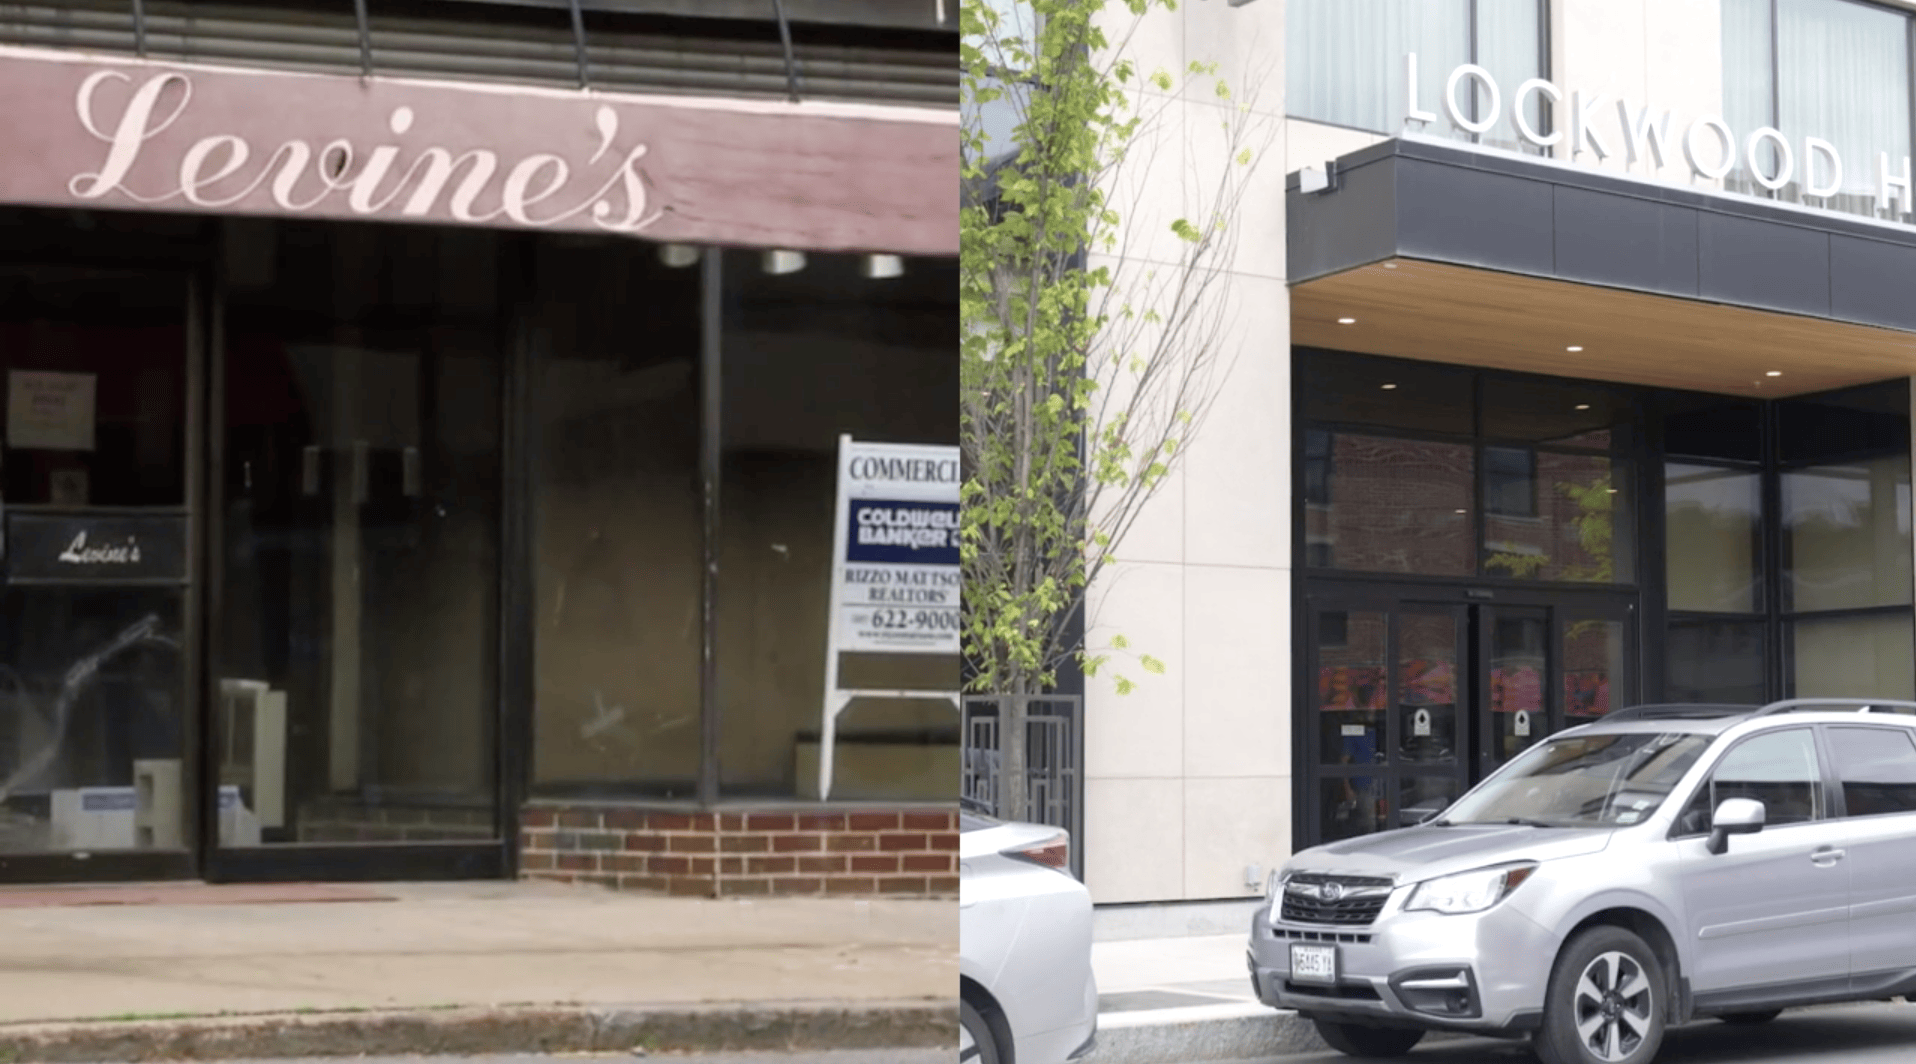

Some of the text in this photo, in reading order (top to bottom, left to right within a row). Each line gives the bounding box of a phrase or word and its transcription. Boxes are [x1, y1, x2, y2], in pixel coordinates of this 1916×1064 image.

[69, 71, 662, 231] Levine's
[1403, 51, 1912, 213] LOCKWOOD H
[845, 568, 892, 585] RIZZO
[858, 528, 948, 549] BANKER
